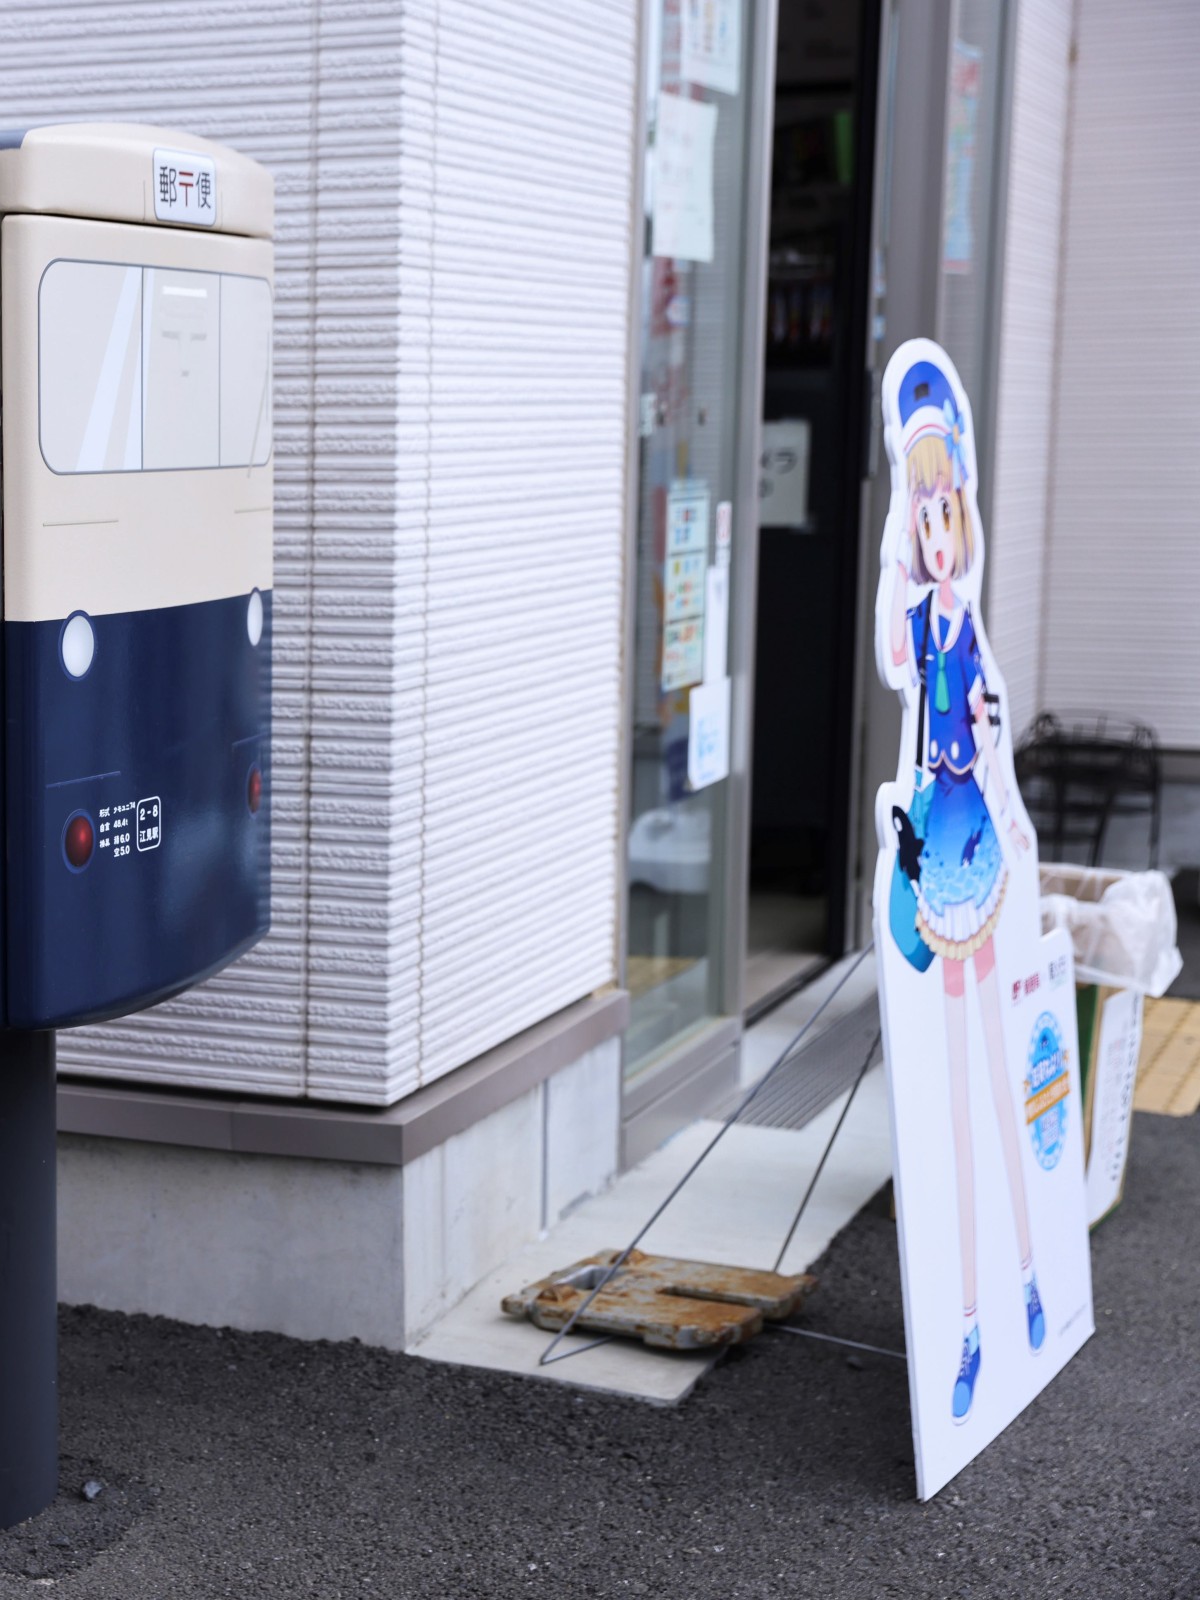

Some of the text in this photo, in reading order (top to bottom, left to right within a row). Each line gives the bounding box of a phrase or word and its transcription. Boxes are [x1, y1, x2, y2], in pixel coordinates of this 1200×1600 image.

[139, 804, 158, 821] 2-8
[139, 826, 159, 843] 江見駅
